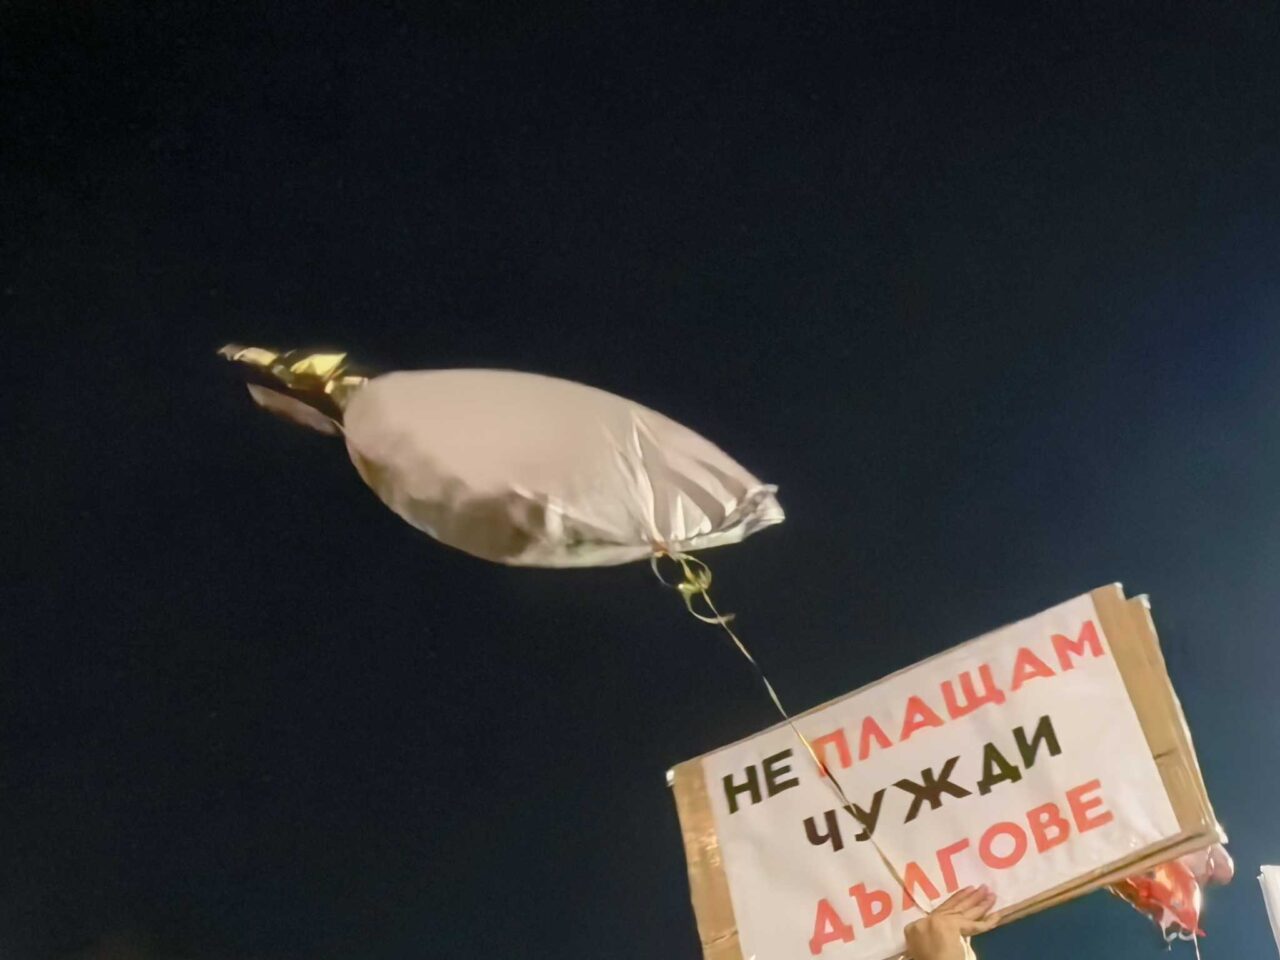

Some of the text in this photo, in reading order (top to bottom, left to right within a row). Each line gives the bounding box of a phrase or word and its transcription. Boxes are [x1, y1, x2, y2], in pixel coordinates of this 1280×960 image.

[722, 620, 1106, 814] НЕ ПЛАЩАМ
[803, 715, 1063, 852] ЧУЖДИ
[808, 779, 1114, 955] ДЪЛГОВЕ
